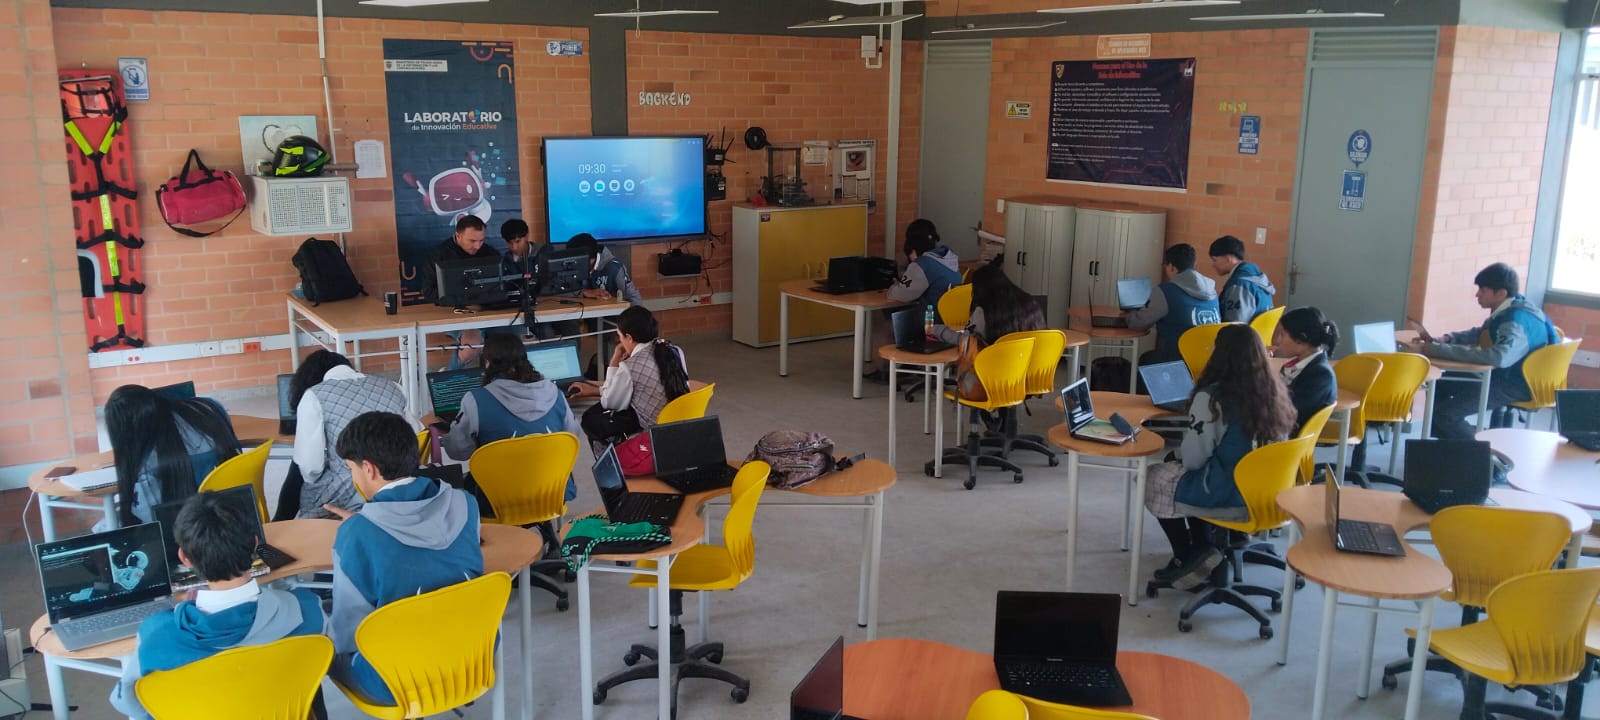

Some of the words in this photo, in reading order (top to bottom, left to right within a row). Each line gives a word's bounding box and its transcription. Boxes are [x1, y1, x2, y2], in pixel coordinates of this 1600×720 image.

[639, 92, 691, 106] BACKEND
[404, 110, 502, 123] LABORATORIO
[421, 122, 461, 131] Innovación
[462, 122, 497, 130] Educativa
[578, 163, 606, 174] 09:30
